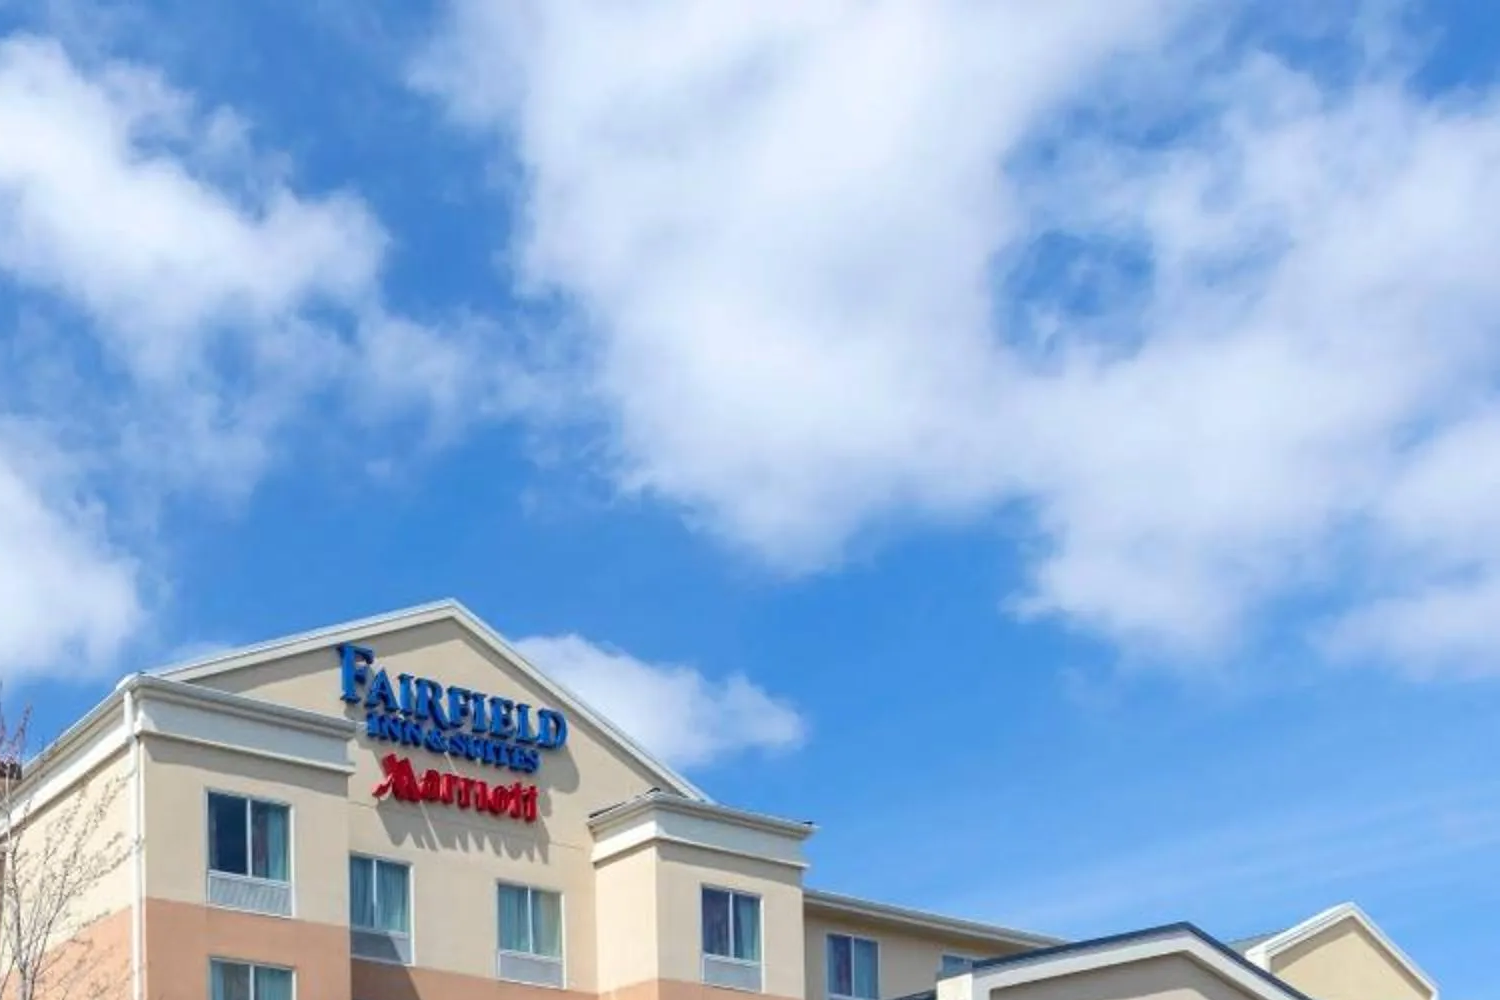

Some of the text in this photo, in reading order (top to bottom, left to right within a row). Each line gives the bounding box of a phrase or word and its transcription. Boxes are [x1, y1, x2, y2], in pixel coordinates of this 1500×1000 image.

[337, 642, 569, 750] FAIRFIELD
[366, 711, 541, 774] INN & SUITES
[372, 753, 538, 822] Marriott
